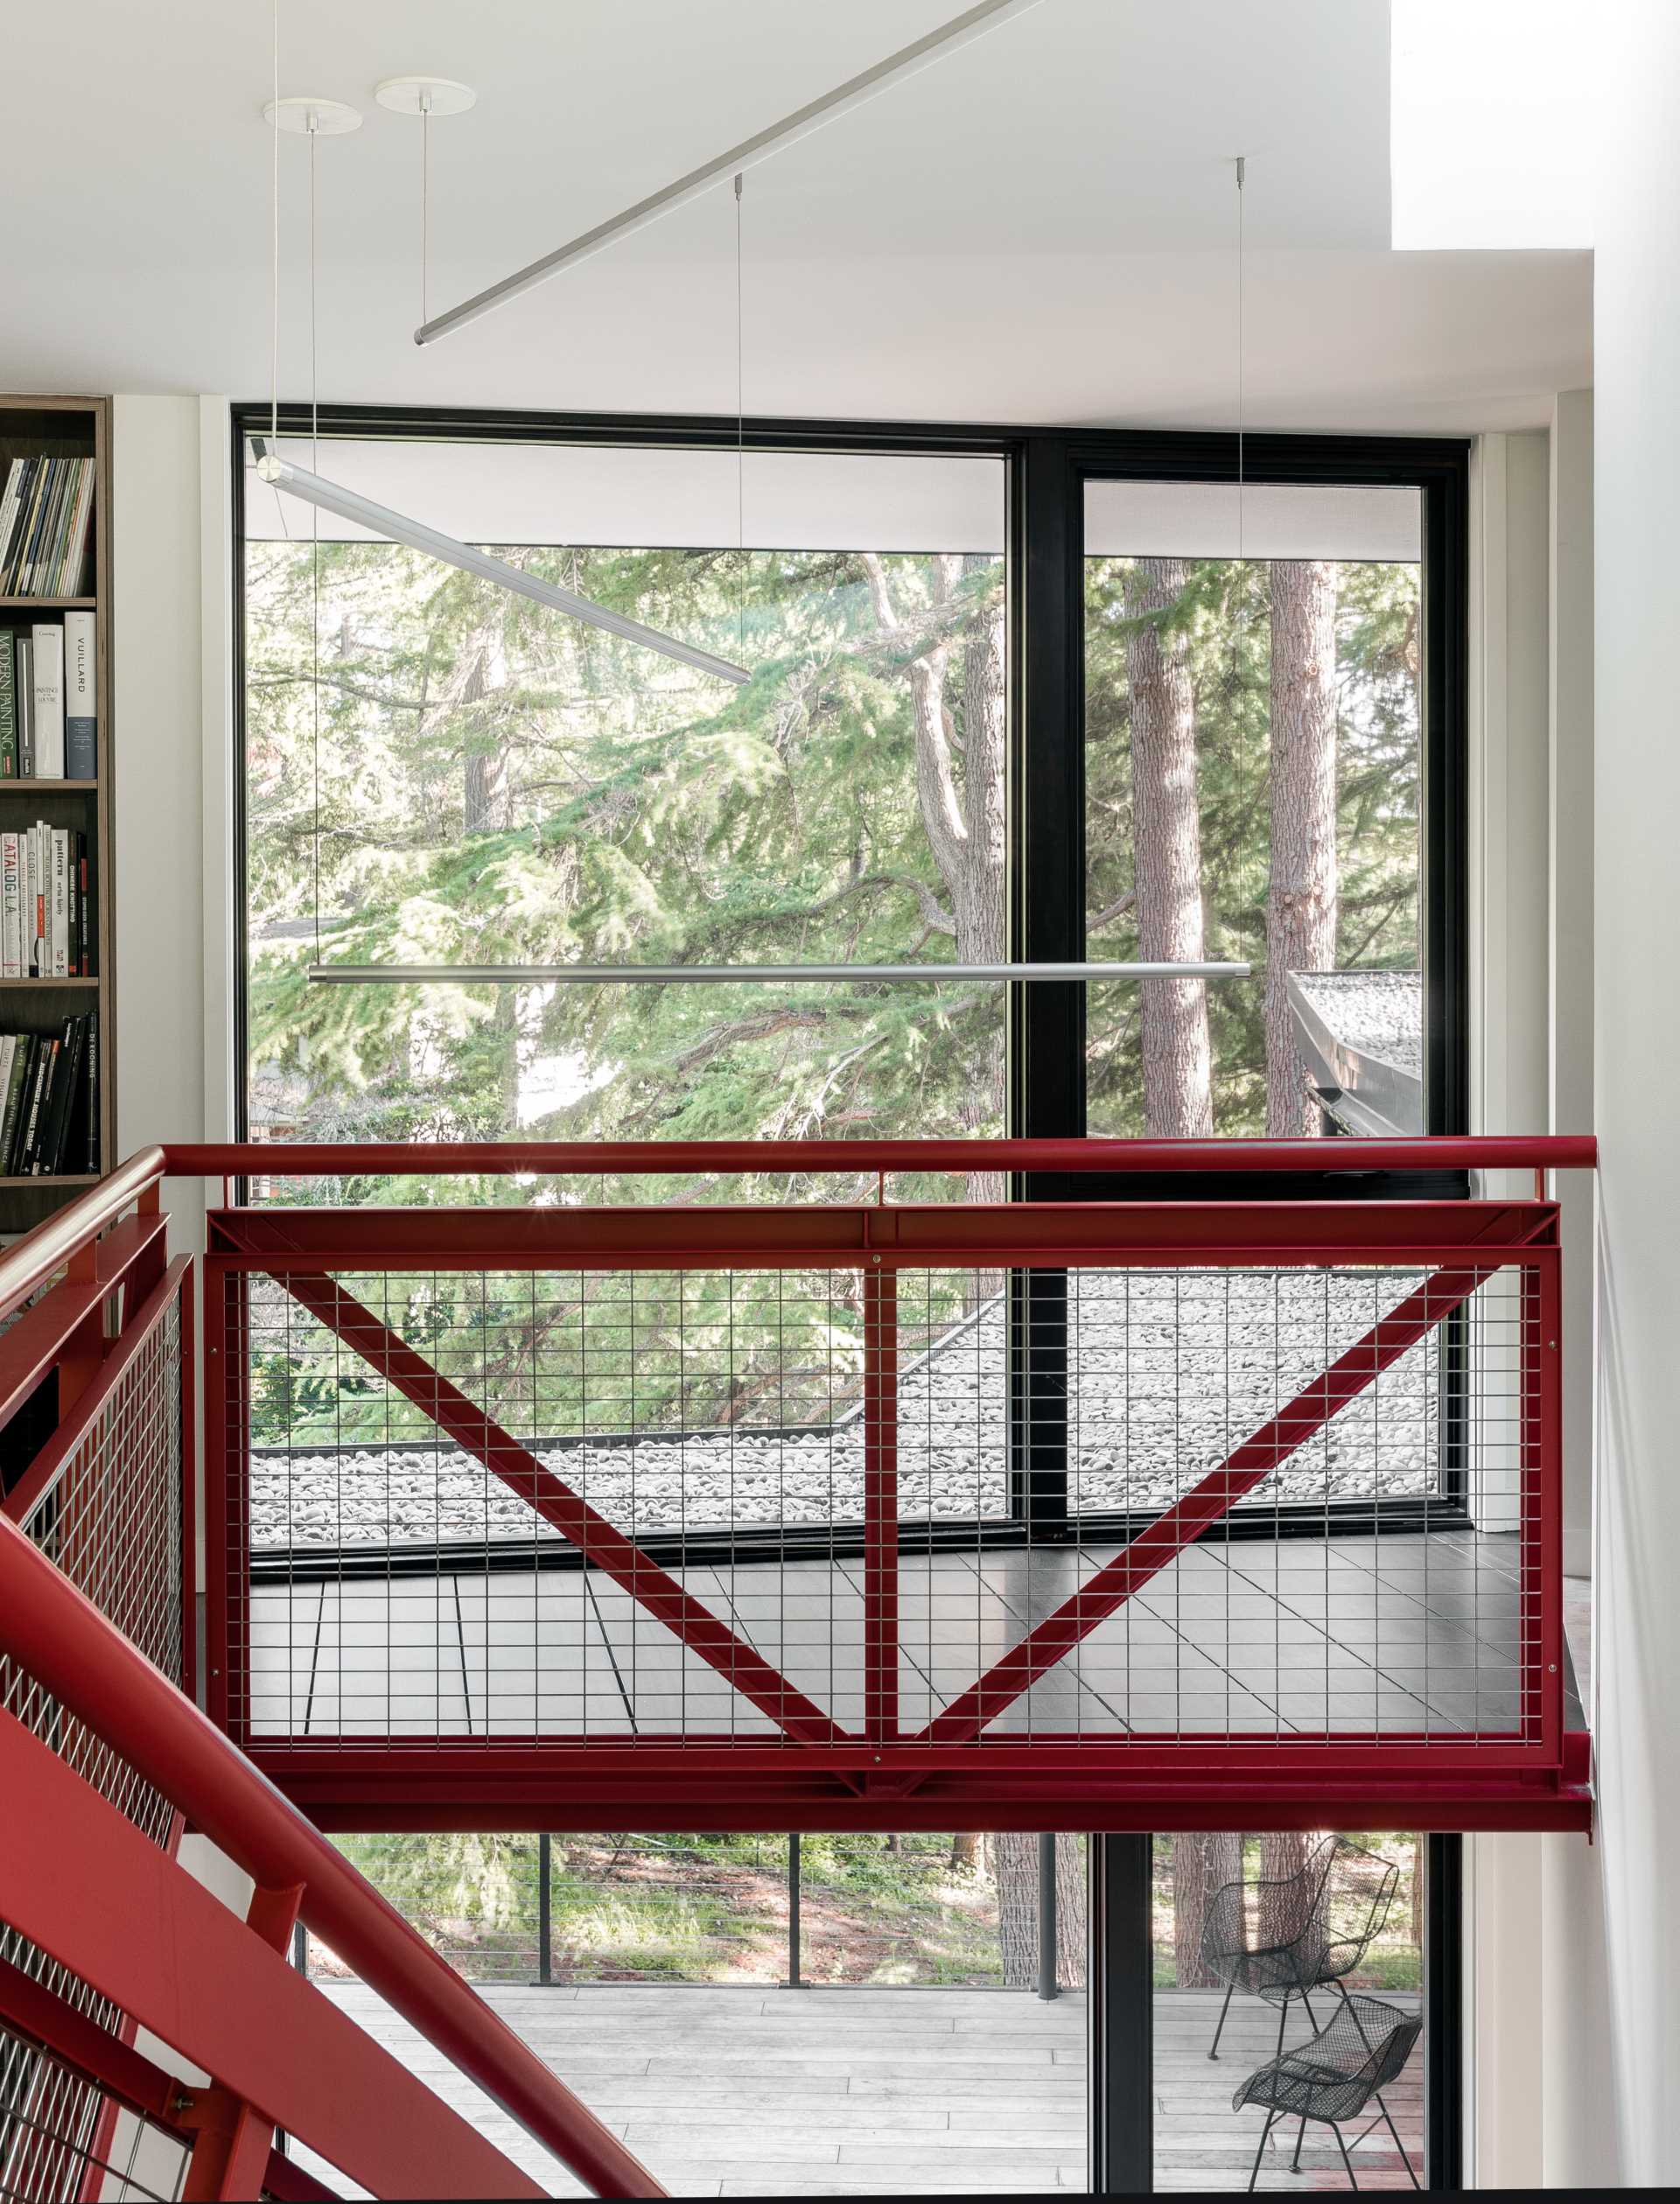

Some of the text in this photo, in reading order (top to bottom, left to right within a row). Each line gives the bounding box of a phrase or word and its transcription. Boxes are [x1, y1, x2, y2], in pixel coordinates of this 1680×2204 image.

[0, 636, 10, 689] MODERN
[0, 693, 13, 750] PAINTING
[4, 836, 17, 892] CATALOG
[55, 839, 64, 876] pattern
[4, 895, 17, 917] L.A.
[6, 1088, 18, 1125] BEAUTIFUL
[25, 1062, 46, 1151] MIDCENTURY HOUSES TODAY
